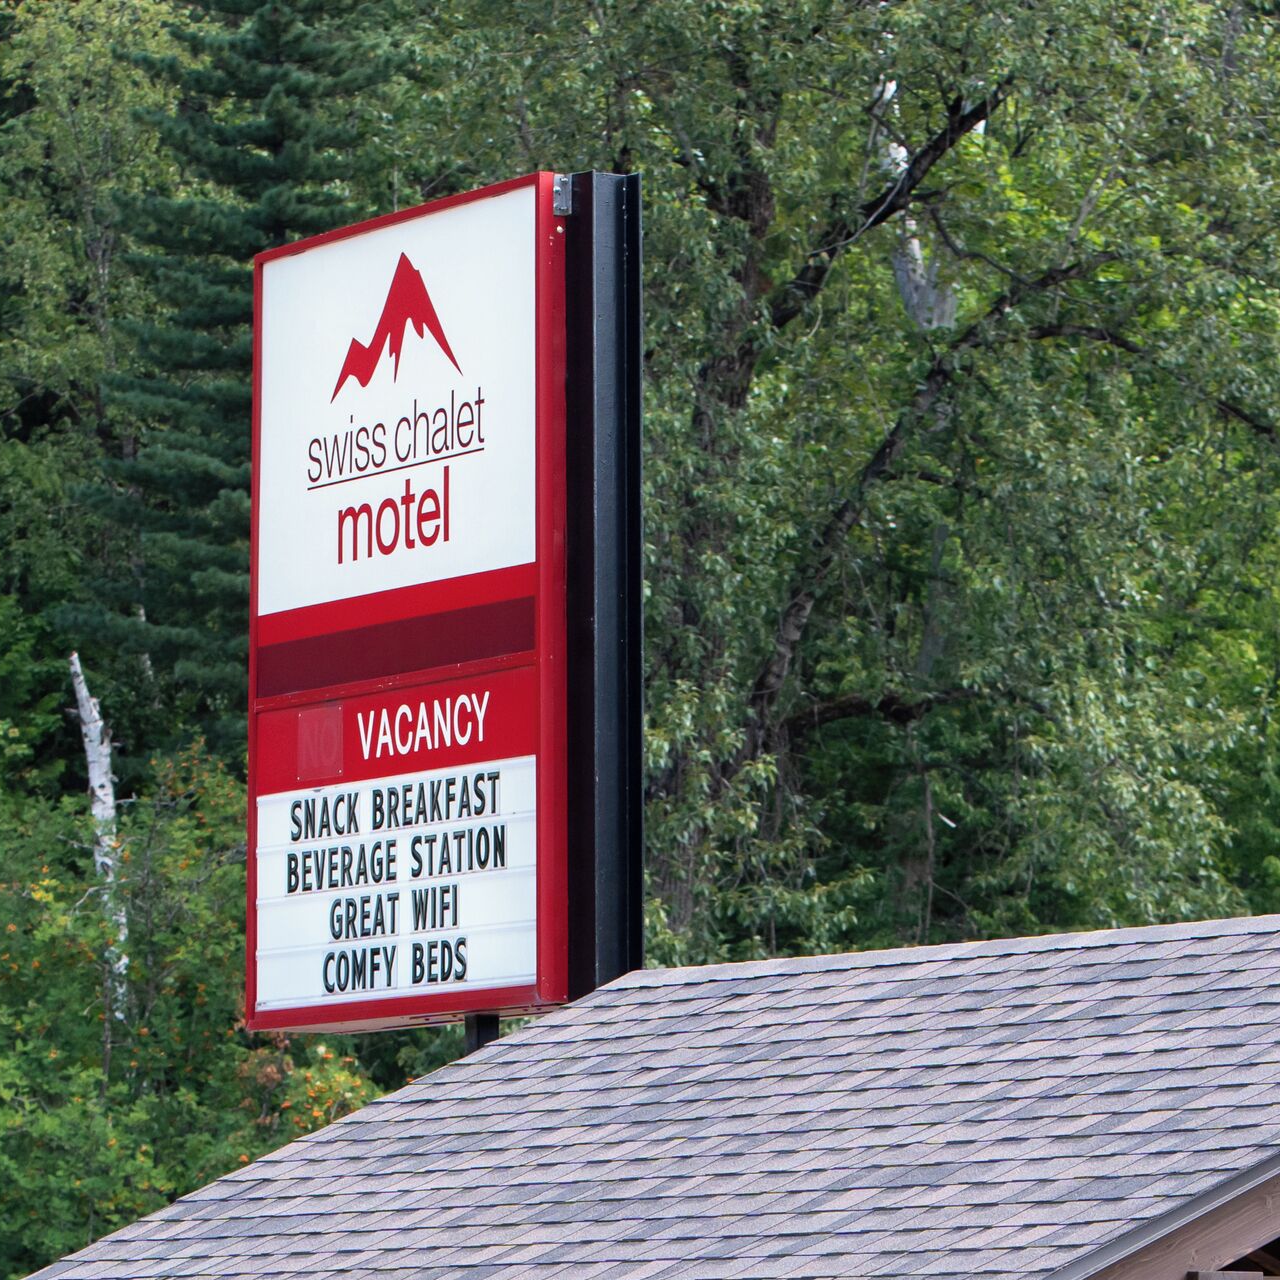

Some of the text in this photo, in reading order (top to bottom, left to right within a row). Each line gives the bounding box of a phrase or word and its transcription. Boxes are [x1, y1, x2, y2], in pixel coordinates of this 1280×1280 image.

[307, 386, 485, 483] swiss chalet
[337, 465, 450, 565] motel
[356, 690, 490, 760] VACANCY
[290, 771, 500, 842] SNACK BREAKFAST
[287, 825, 505, 894] BEVERAGE STATION
[330, 884, 458, 941] GREAT WIFI
[323, 937, 467, 994] COMFY BEDS
